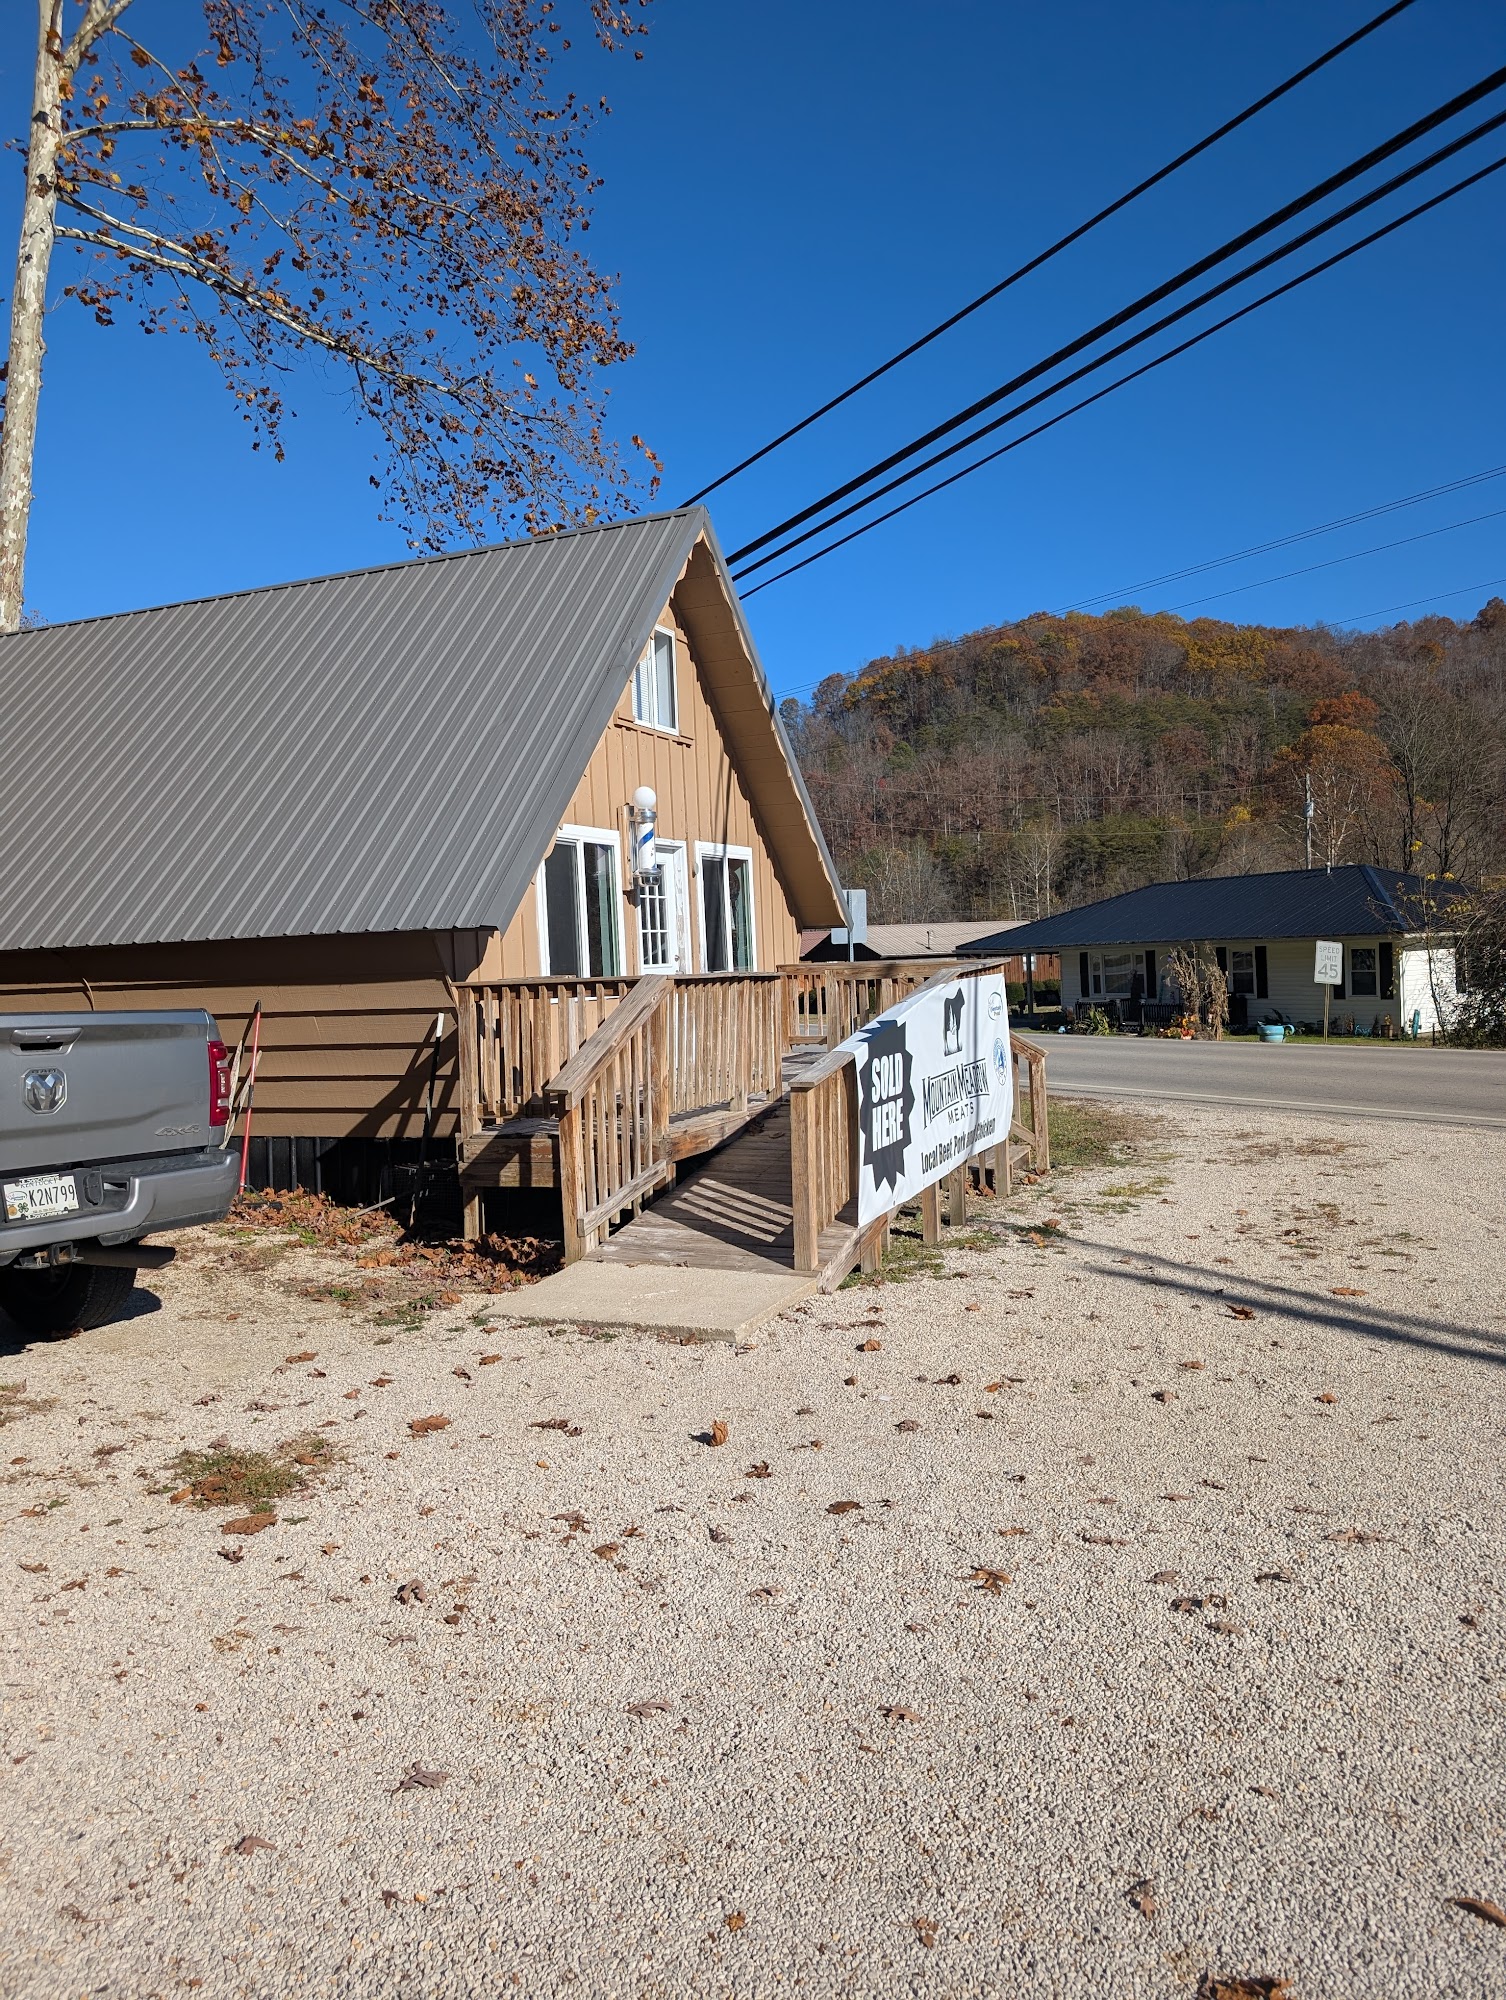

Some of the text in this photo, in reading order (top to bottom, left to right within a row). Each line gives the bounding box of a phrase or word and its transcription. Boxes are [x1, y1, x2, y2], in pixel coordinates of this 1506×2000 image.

[1319, 946, 1339, 954] SPEED
[1318, 963, 1338, 978] 45
[871, 1052, 903, 1103] SOLD
[871, 1097, 904, 1152] HERE
[947, 1101, 975, 1125] MEATS
[920, 1145, 939, 1175] Local
[953, 1131, 967, 1157] Pork
[966, 1128, 976, 1149] and
[974, 1118, 996, 1143] Chicken
[20, 1176, 58, 1189] KENTUCKY
[28, 1184, 75, 1207] K2N799
